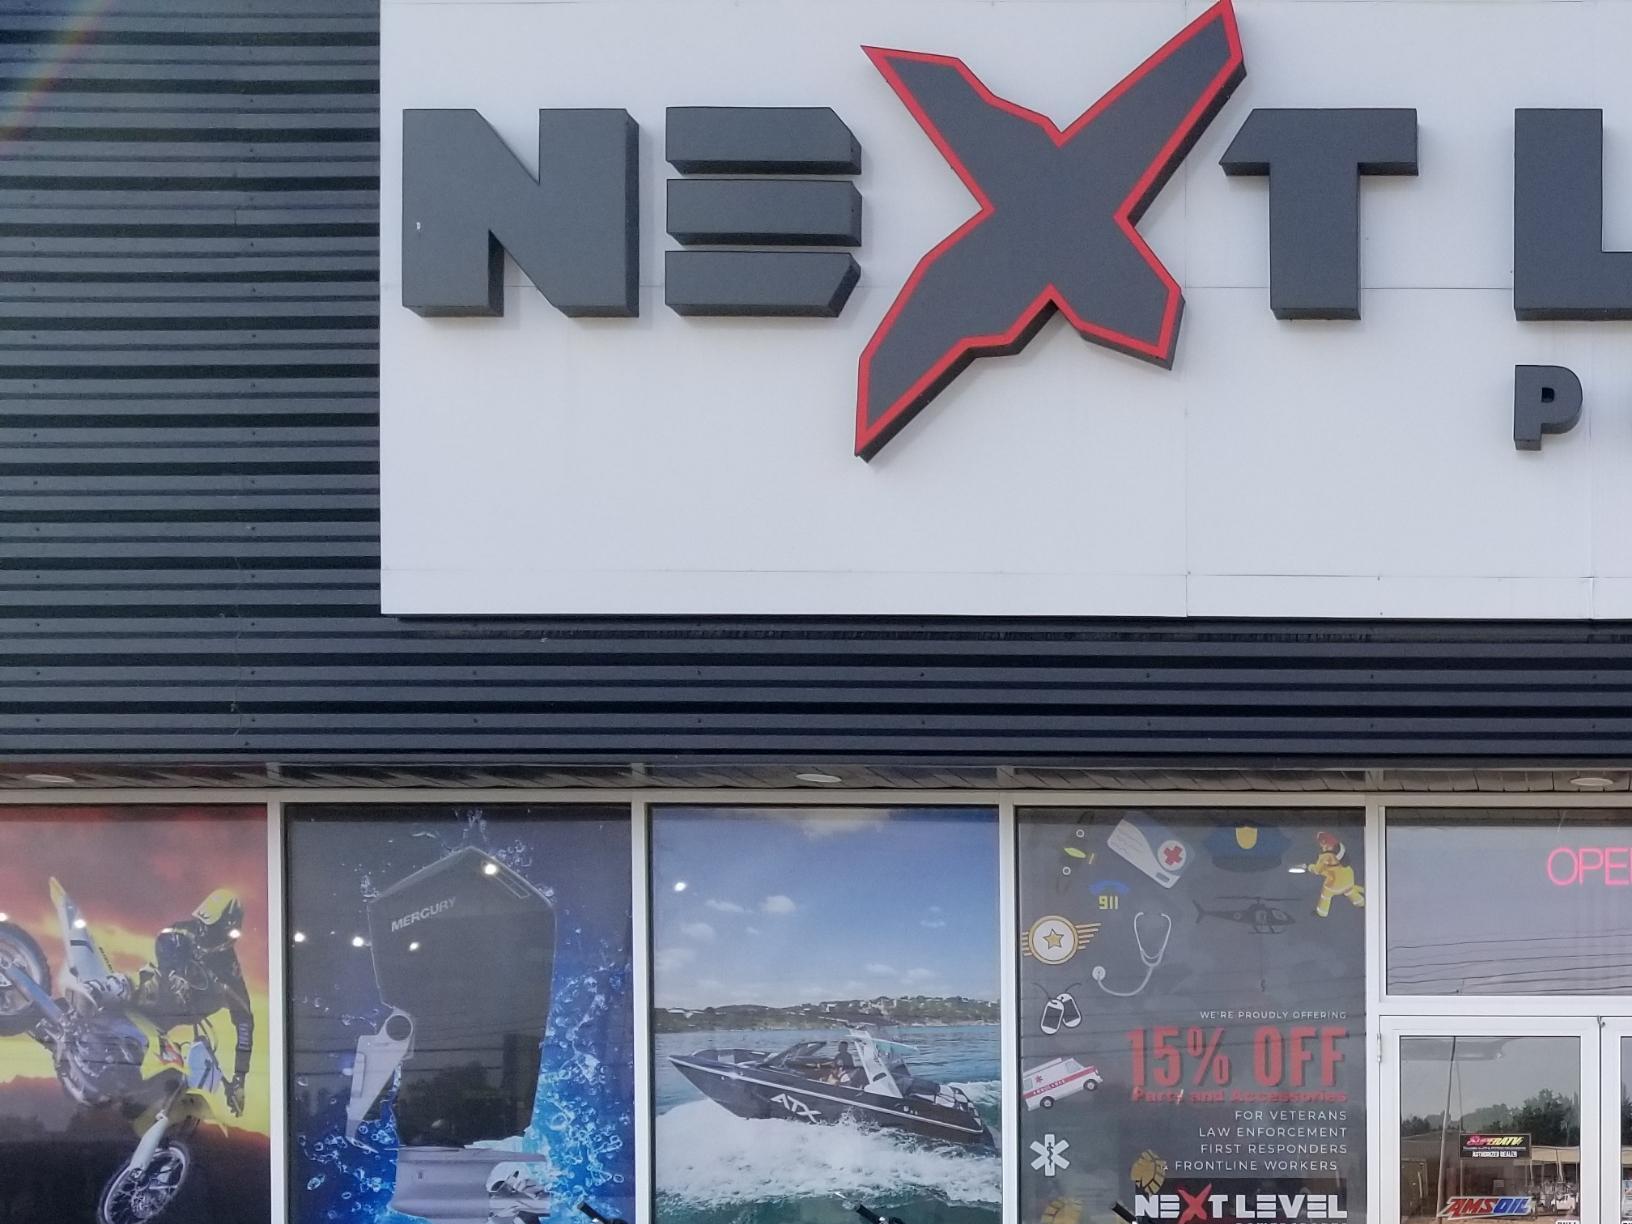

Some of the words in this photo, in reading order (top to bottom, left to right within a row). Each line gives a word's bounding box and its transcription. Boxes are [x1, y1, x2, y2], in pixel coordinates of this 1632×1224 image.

[402, 0, 1418, 464] NEXT
[1098, 895, 1119, 911] 911
[391, 897, 457, 932] MERCURY
[1199, 1010, 1234, 1020] WE'RE
[1237, 1010, 1288, 1020] PROUDLY
[1291, 1010, 1347, 1020] OFFERING
[1126, 1025, 1231, 1087] 15%
[1253, 1026, 1348, 1087] OFF
[770, 1093, 822, 1123] ATX
[1235, 1110, 1264, 1121] FOR
[1269, 1110, 1348, 1121] VETERANS
[1199, 1127, 1231, 1137] LAW
[1237, 1127, 1347, 1137] ENFORCEMENT
[1201, 1143, 1241, 1154] FIRST
[1248, 1143, 1347, 1154] RESPONDERS
[1175, 1160, 1258, 1171] FRONTLINE
[1264, 1160, 1338, 1171] WORKERS
[1235, 1194, 1348, 1219] LEVEL
[1443, 1196, 1531, 1218] AMSOIL
